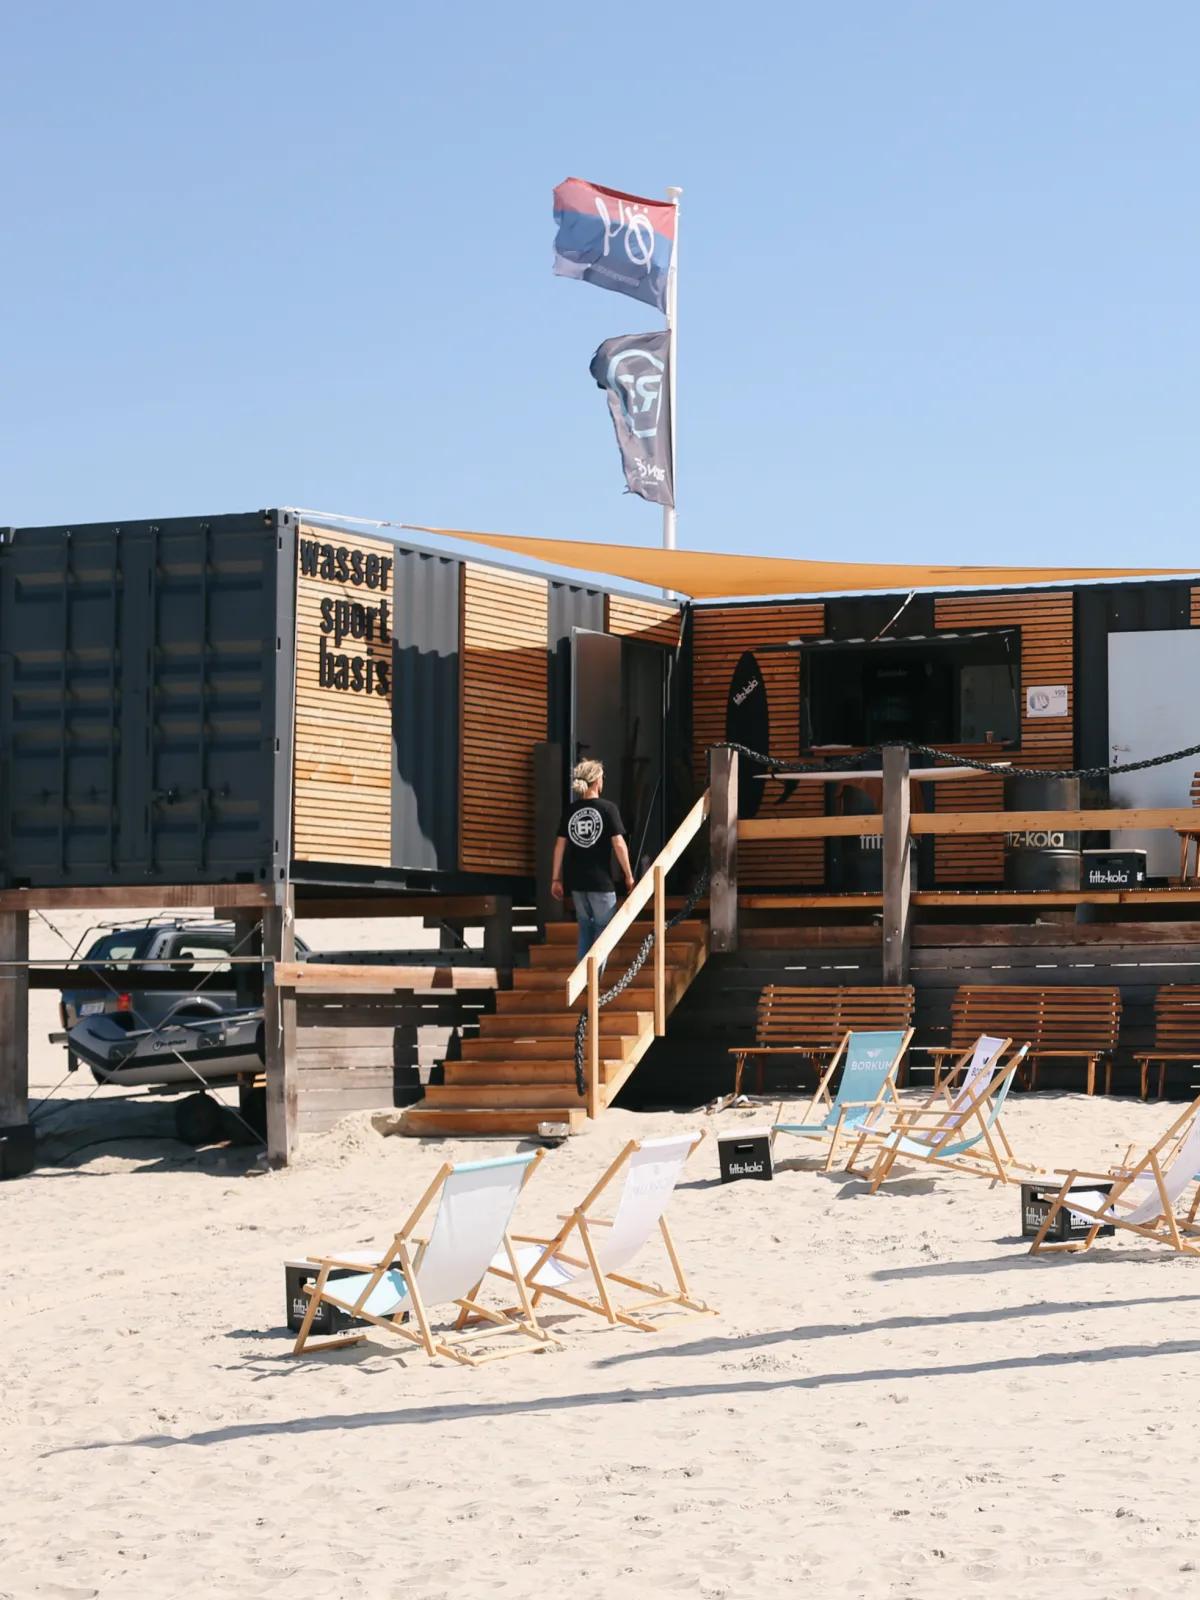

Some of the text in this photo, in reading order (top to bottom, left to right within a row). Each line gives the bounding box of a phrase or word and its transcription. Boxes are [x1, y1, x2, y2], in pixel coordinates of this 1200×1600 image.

[300, 538, 393, 592] wasser
[319, 597, 390, 648] sport
[319, 635, 390, 697] basis
[1088, 869, 1128, 884] fritz-kola
[729, 1161, 763, 1175] fritz-kola
